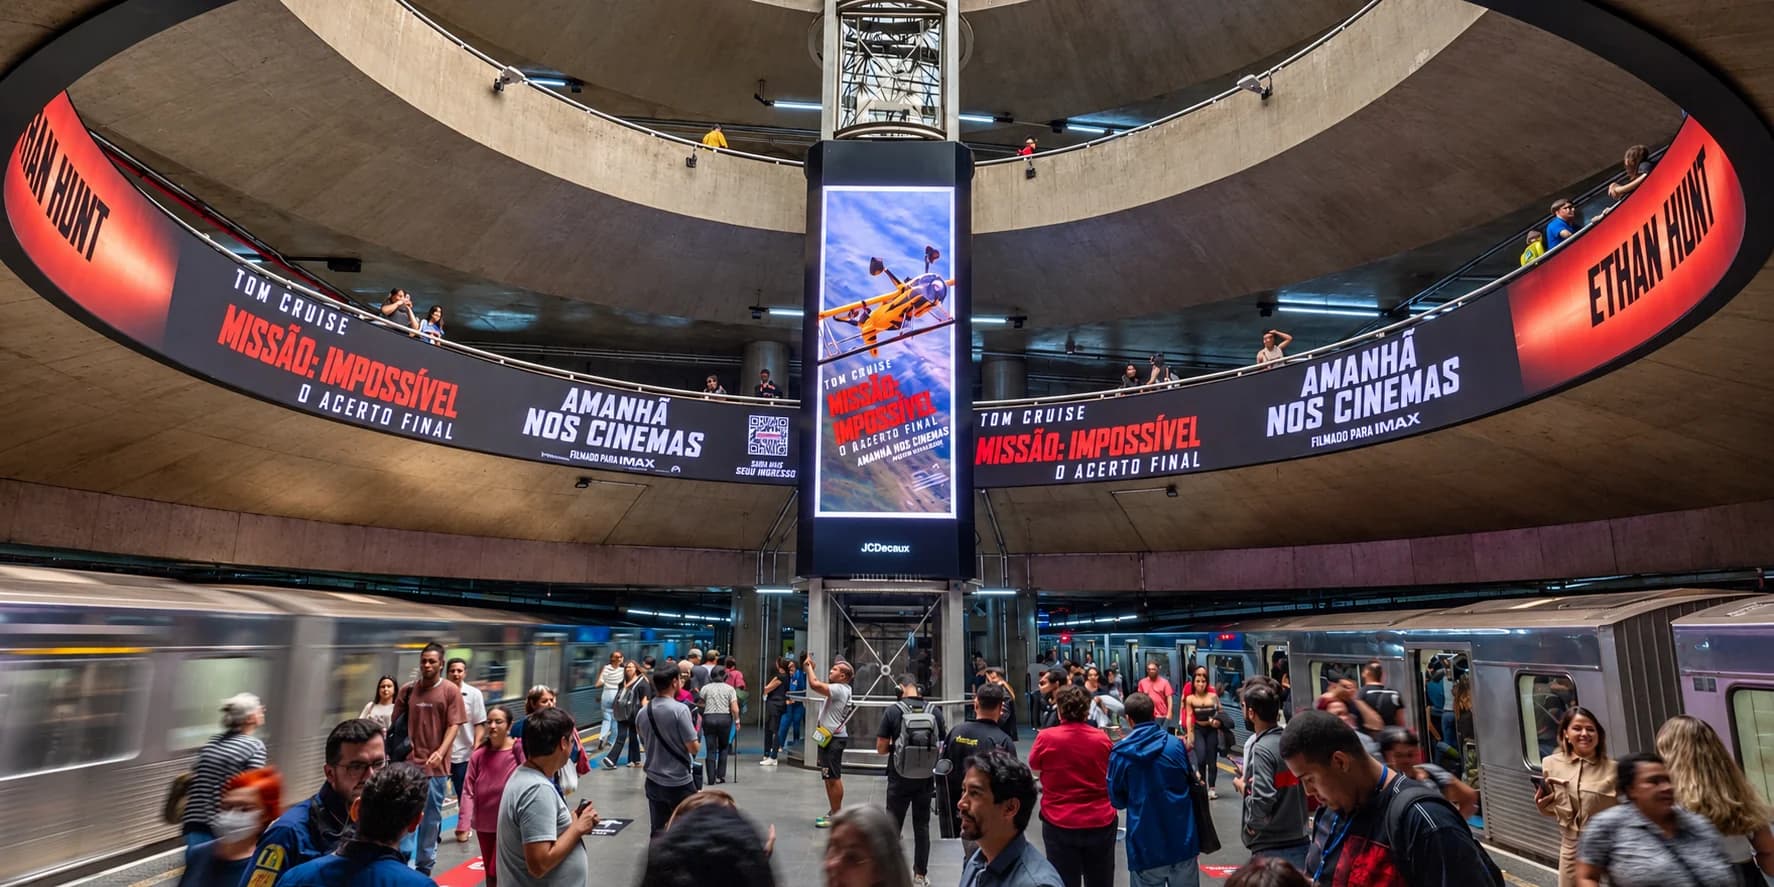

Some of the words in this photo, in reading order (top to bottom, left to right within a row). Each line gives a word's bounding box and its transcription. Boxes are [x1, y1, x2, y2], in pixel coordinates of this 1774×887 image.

[46, 153, 110, 262] HUNT
[1588, 213, 1664, 328] ETHAN
[1664, 144, 1714, 272] HUNT
[234, 268, 272, 304] TOM
[279, 292, 349, 336] CRUISE
[217, 303, 319, 379] MISSÃO:
[319, 345, 459, 419] IMPOSSÍVEL
[824, 374, 846, 390] TOM
[851, 359, 892, 381] CRUISE
[1301, 327, 1417, 398] AMANHÃ
[298, 384, 312, 403] O
[318, 391, 393, 426] ACERTO
[401, 413, 453, 440] FINAL
[560, 387, 671, 426] AMANHÃ
[980, 411, 1012, 427] TOM
[1022, 405, 1086, 424] CRUISE
[1266, 396, 1324, 437] NOS
[1333, 356, 1460, 424] CINEMAS
[522, 407, 580, 443] NOS
[586, 420, 705, 458] CINEMAS
[839, 445, 847, 457] O
[912, 426, 950, 447] CINEMAS
[975, 428, 1064, 465] MISSÃO:
[1068, 412, 1201, 460] IMPOSSÍVEL
[1311, 430, 1349, 448] FILMADO
[1350, 426, 1374, 441] PARA
[1375, 412, 1421, 435] IMAX
[570, 450, 599, 463] FILMADO
[600, 452, 618, 465] PARA
[619, 455, 656, 469] IMAX
[1055, 465, 1065, 480] O
[1074, 458, 1141, 479] ACERTO
[1150, 451, 1201, 473] FINAL
[861, 543, 910, 553] JCDecaux
